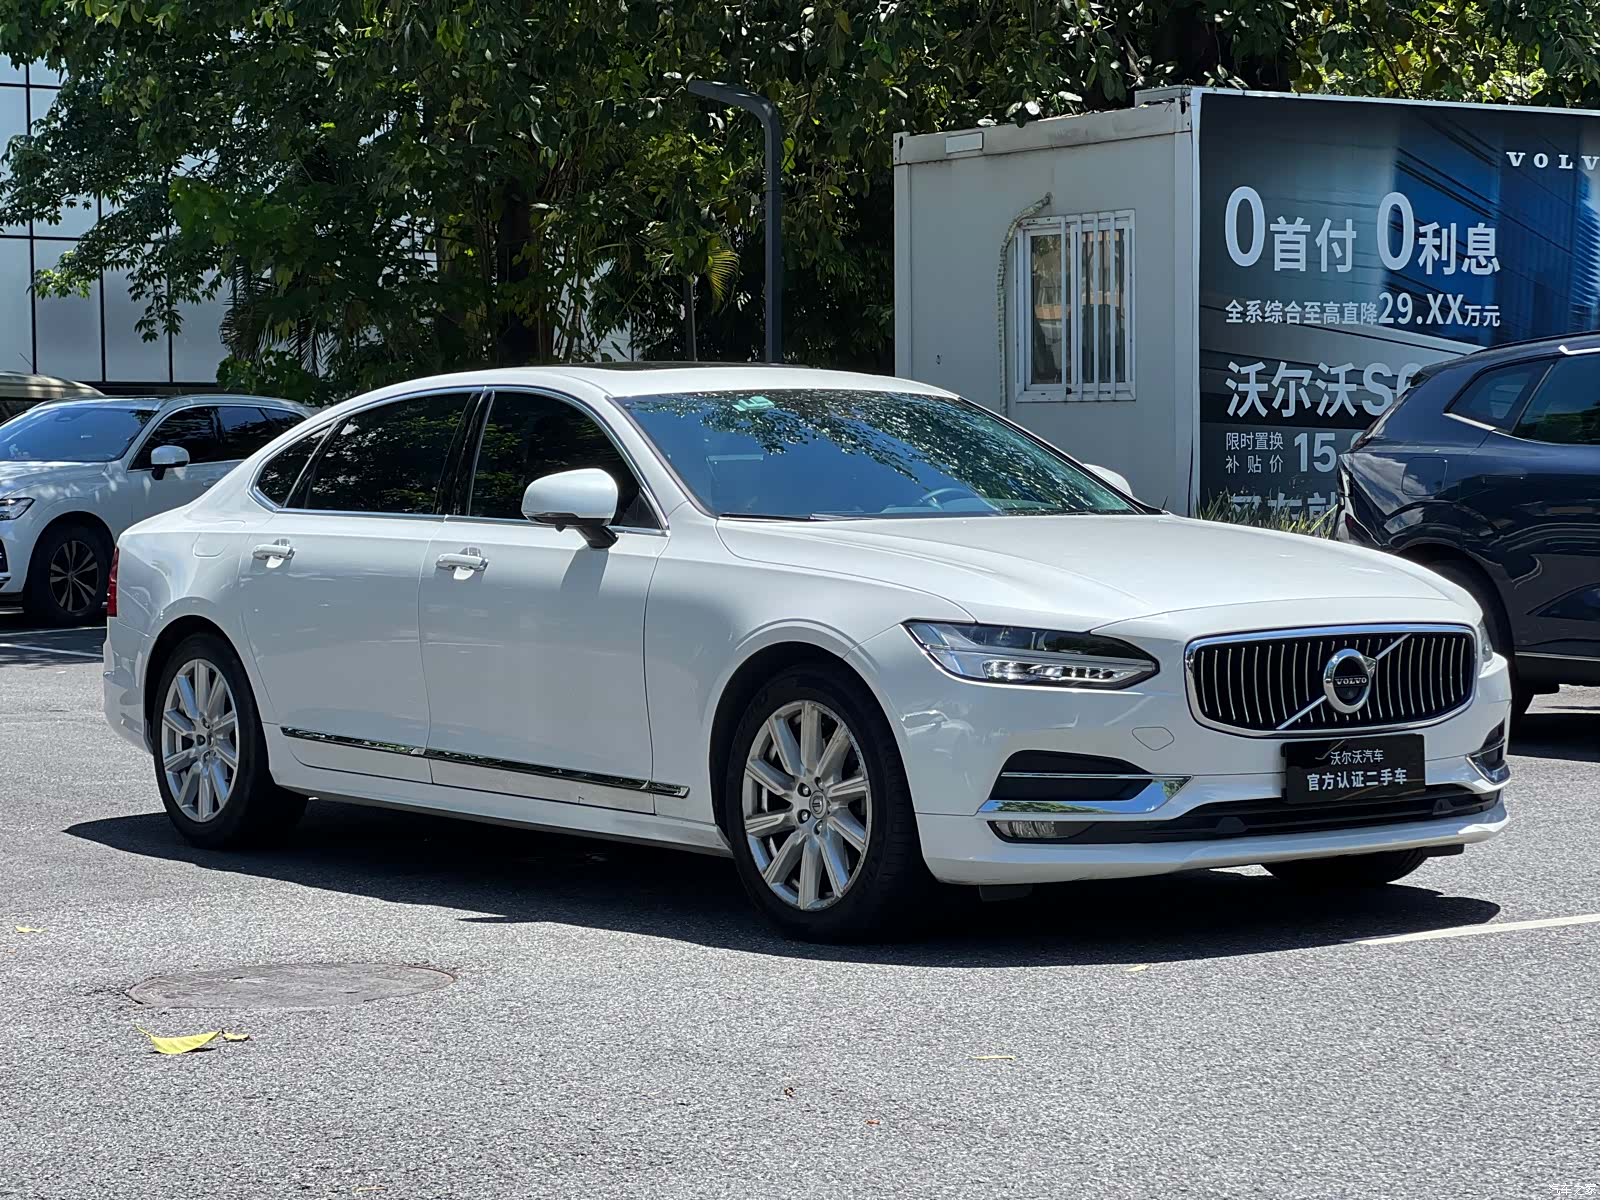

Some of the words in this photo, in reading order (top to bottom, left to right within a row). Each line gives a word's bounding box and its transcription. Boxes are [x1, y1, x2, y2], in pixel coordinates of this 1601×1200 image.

[1225, 186, 1356, 273] 0首付
[1377, 192, 1500, 276] 0利息
[1225, 292, 1500, 327] 全系综合至高直降29.XX万元
[1225, 432, 1284, 451] 限时置换
[1335, 677, 1367, 685] VOLVO
[1330, 749, 1384, 766] 沃尔沃汽车
[1307, 768, 1407, 792] 官方认证二手车
